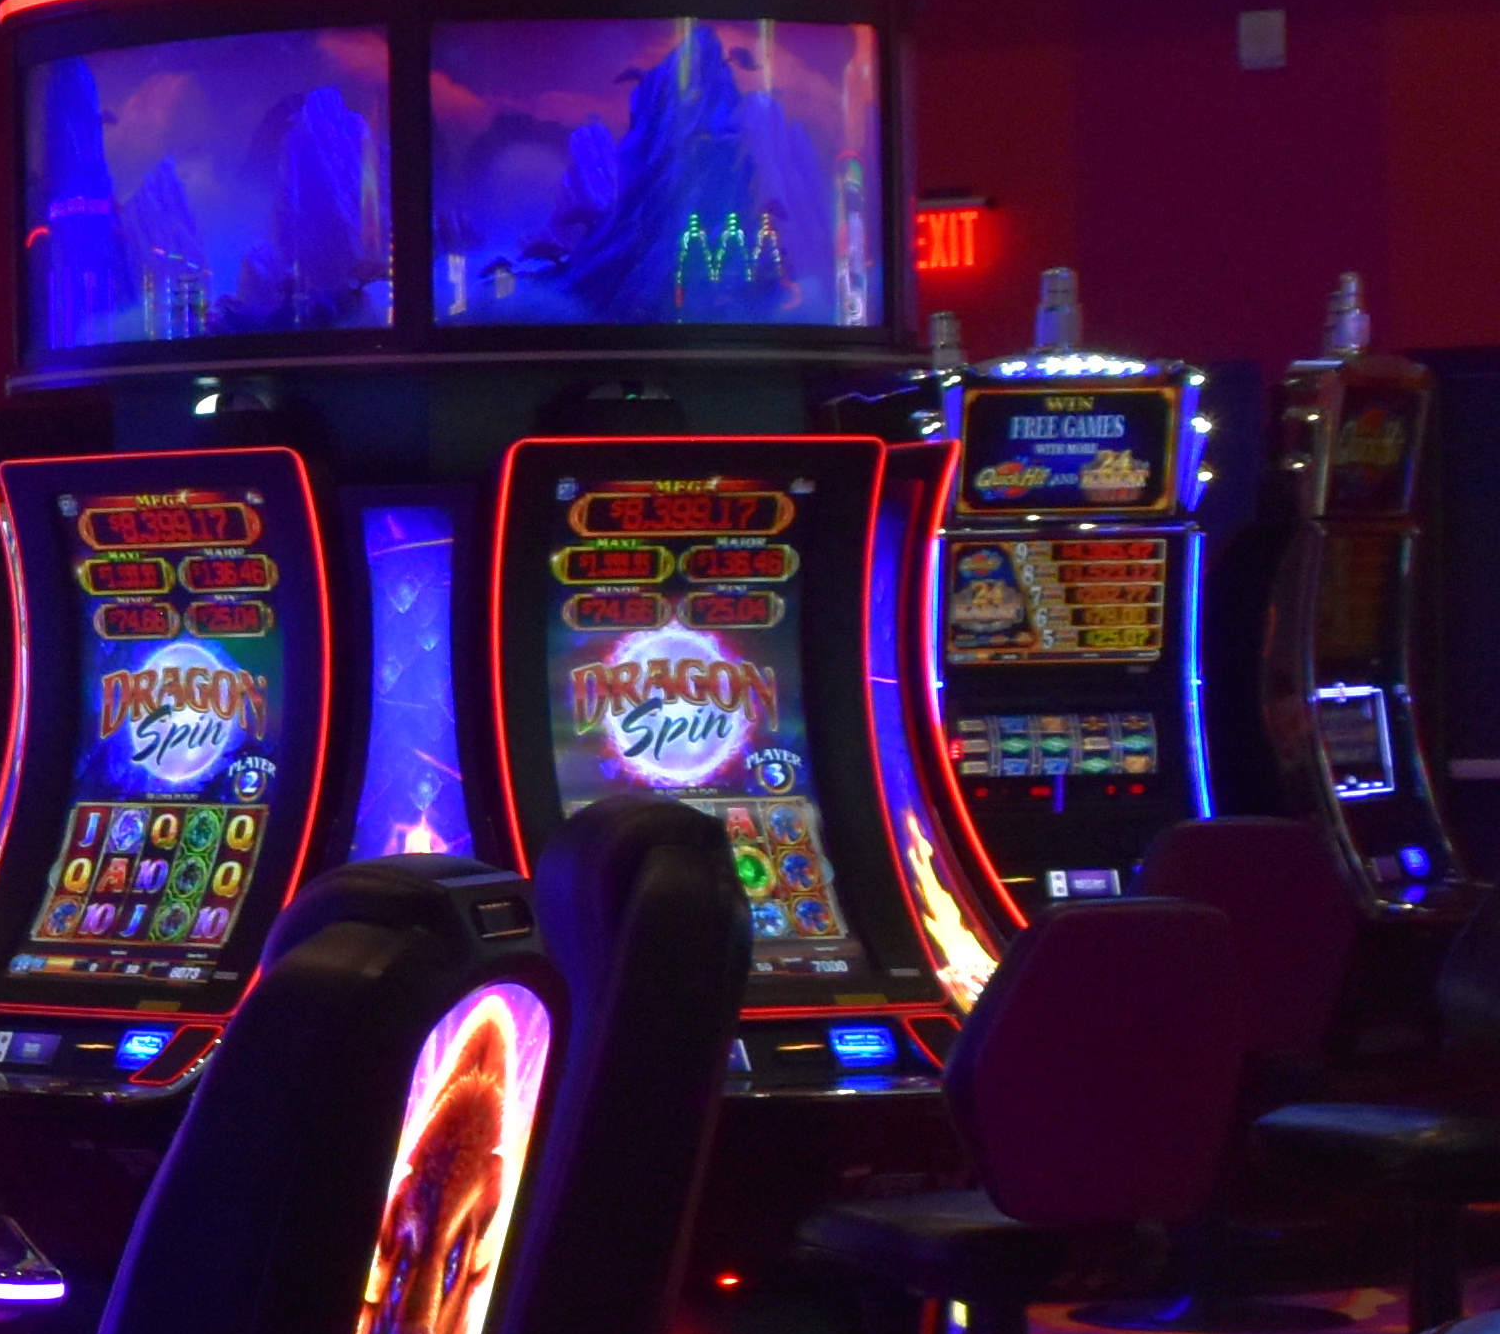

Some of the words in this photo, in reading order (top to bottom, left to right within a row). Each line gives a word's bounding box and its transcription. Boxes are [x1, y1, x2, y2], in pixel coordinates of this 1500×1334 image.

[1045, 396, 1094, 411] WIN
[1010, 416, 1059, 439] FREE
[1063, 415, 1125, 438] GAMES
[1049, 474, 1078, 485] AND
[100, 667, 267, 740] DRAGON
[571, 657, 779, 735] DRAGON
[132, 704, 223, 764] Spin
[621, 697, 733, 760] Spin
[229, 756, 276, 777] PLAYER
[746, 748, 802, 770] PLAYER
[243, 771, 258, 793] 2
[771, 763, 786, 786] 3
